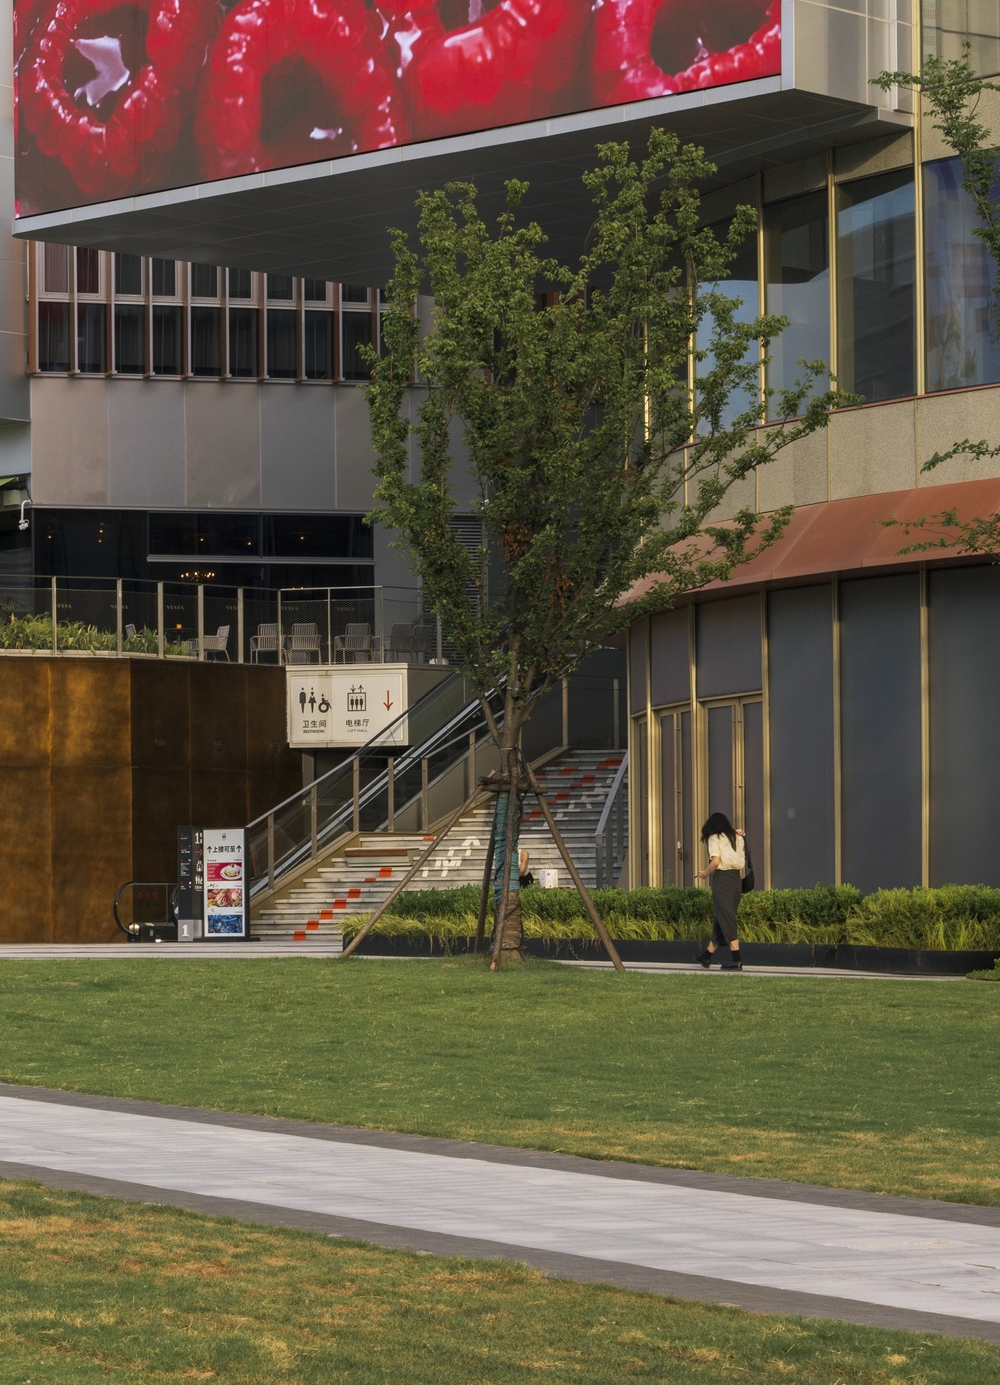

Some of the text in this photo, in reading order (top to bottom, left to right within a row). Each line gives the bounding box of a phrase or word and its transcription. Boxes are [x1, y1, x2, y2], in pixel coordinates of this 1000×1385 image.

[302, 720, 327, 728] 卫生间
[345, 719, 370, 727] 电梯厅
[212, 845, 236, 854] 上楼可至
[181, 924, 189, 937] 1
